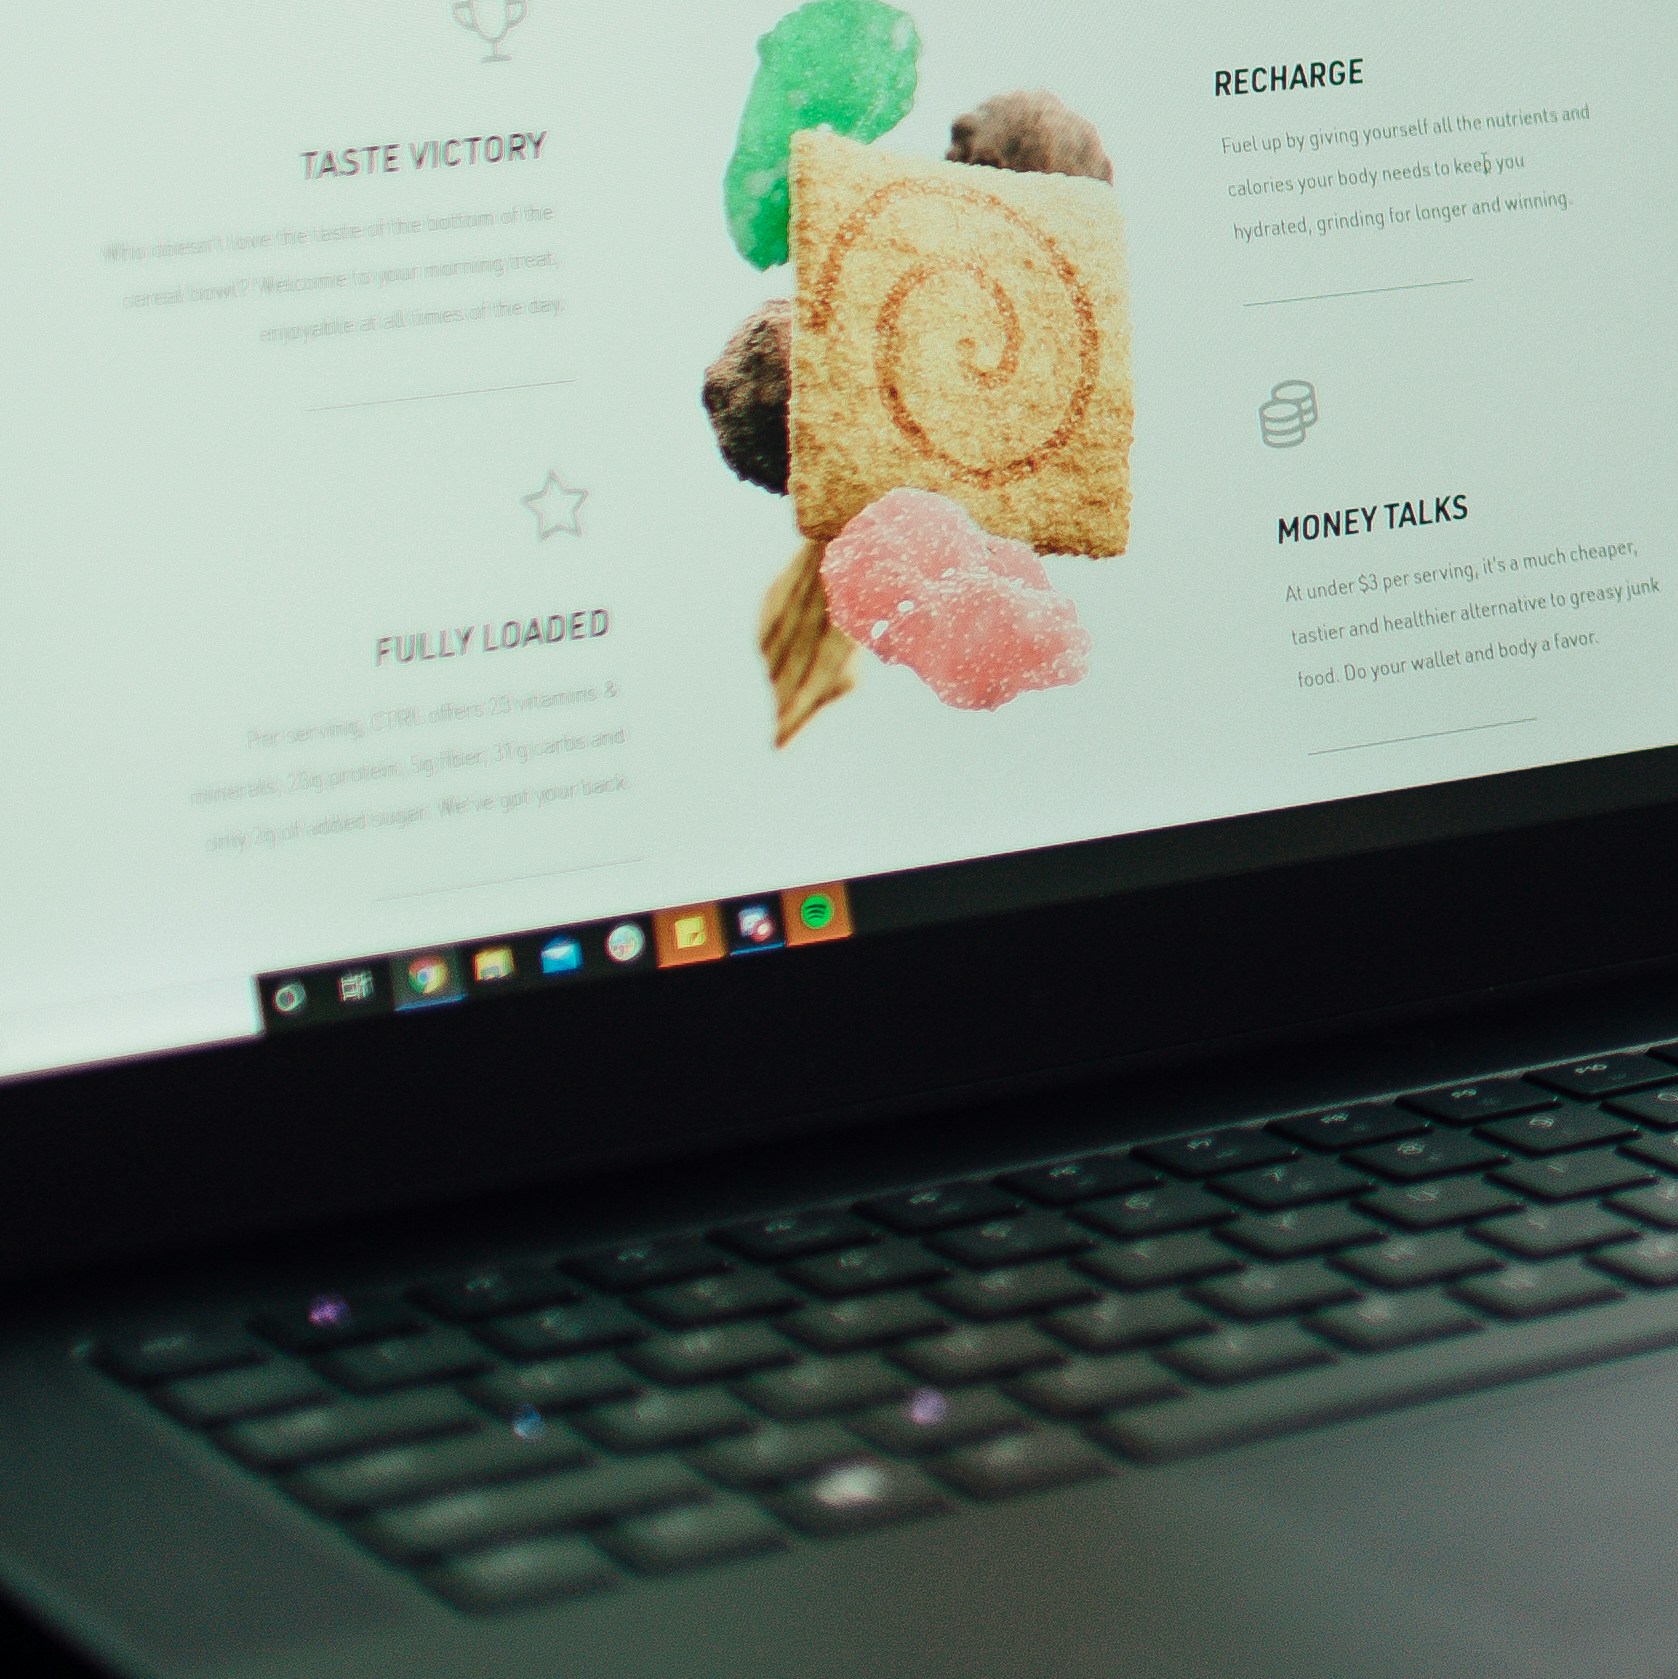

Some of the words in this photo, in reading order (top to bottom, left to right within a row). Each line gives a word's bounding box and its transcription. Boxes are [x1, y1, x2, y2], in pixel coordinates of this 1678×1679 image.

[1213, 57, 1365, 97] RECHARGE
[299, 143, 400, 182] TASTE
[409, 129, 549, 172] VICTORY
[1221, 134, 1259, 156] Fuel
[1262, 134, 1283, 154] up
[1285, 129, 1306, 154] by
[1308, 127, 1360, 152] giving
[1362, 117, 1430, 145] yourself
[1432, 116, 1454, 137] all
[1456, 112, 1483, 134] the
[1484, 106, 1559, 132] nutrients
[1561, 102, 1592, 123] and
[1227, 175, 1295, 199] calories
[1297, 172, 1335, 195] your
[1338, 166, 1379, 189] body
[1381, 161, 1432, 183] needs
[1434, 160, 1452, 178] to
[1494, 154, 1527, 174] you
[1232, 216, 1314, 244] hydrated,
[1316, 208, 1386, 237] grinding
[1387, 205, 1412, 226] for
[1414, 201, 1468, 228] longer
[1470, 196, 1502, 217] and
[1504, 189, 1575, 215] winning.
[1276, 505, 1379, 545] MONEY
[1383, 493, 1470, 530] TALKS
[1285, 584, 1304, 604] At
[1306, 577, 1355, 601] under
[1357, 572, 1380, 595] $3
[1382, 573, 1410, 594] per
[1412, 560, 1480, 587] serving,
[1481, 555, 1507, 576] it's
[1508, 557, 1520, 572] a
[1522, 547, 1567, 570] much
[1568, 537, 1640, 563] cheaper,
[375, 623, 476, 669] FULLY
[482, 606, 613, 655] LOADED
[1291, 622, 1345, 647] tastier
[1347, 617, 1380, 638] and
[1382, 606, 1459, 632] healthier
[1459, 592, 1547, 622] alternative
[1549, 590, 1568, 610] to
[1568, 582, 1624, 610] greasy
[1624, 575, 1661, 601] junk
[1296, 666, 1340, 689] food.
[1343, 660, 1367, 682] Do
[1369, 658, 1408, 682] your
[1410, 649, 1462, 673] wallet
[1464, 643, 1496, 665] and
[1497, 636, 1539, 660] body
[1541, 636, 1552, 652] a
[1552, 626, 1601, 651] favor.
